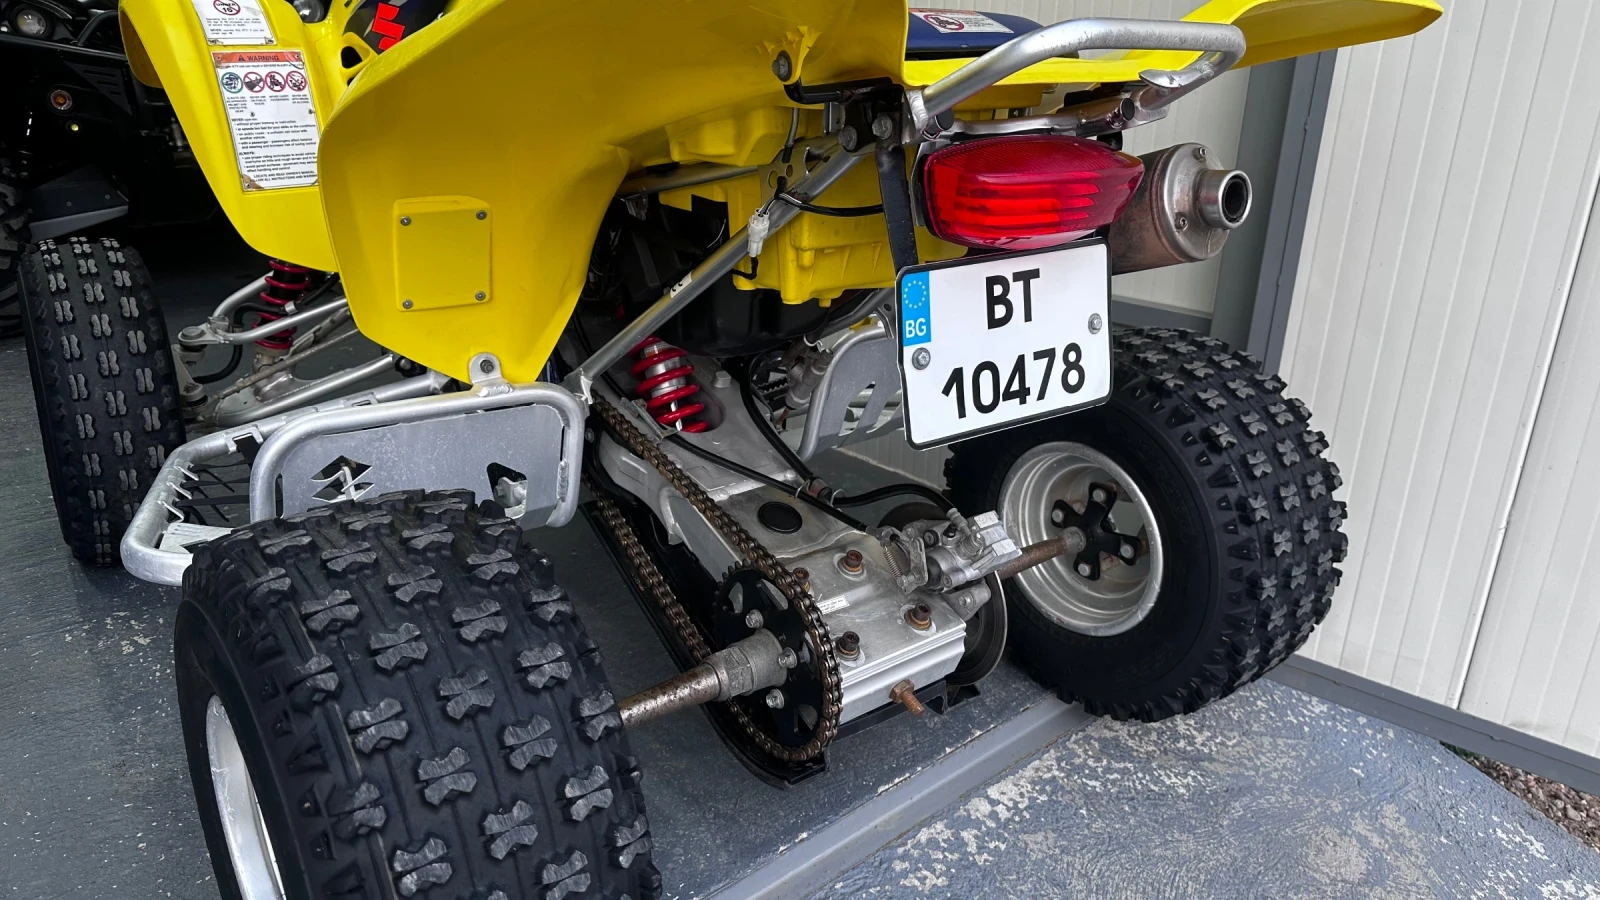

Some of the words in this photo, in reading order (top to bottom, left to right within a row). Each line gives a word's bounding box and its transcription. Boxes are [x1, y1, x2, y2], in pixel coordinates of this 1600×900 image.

[905, 317, 927, 339] BG
[985, 267, 1040, 330] BT
[941, 342, 1086, 419] 10478
